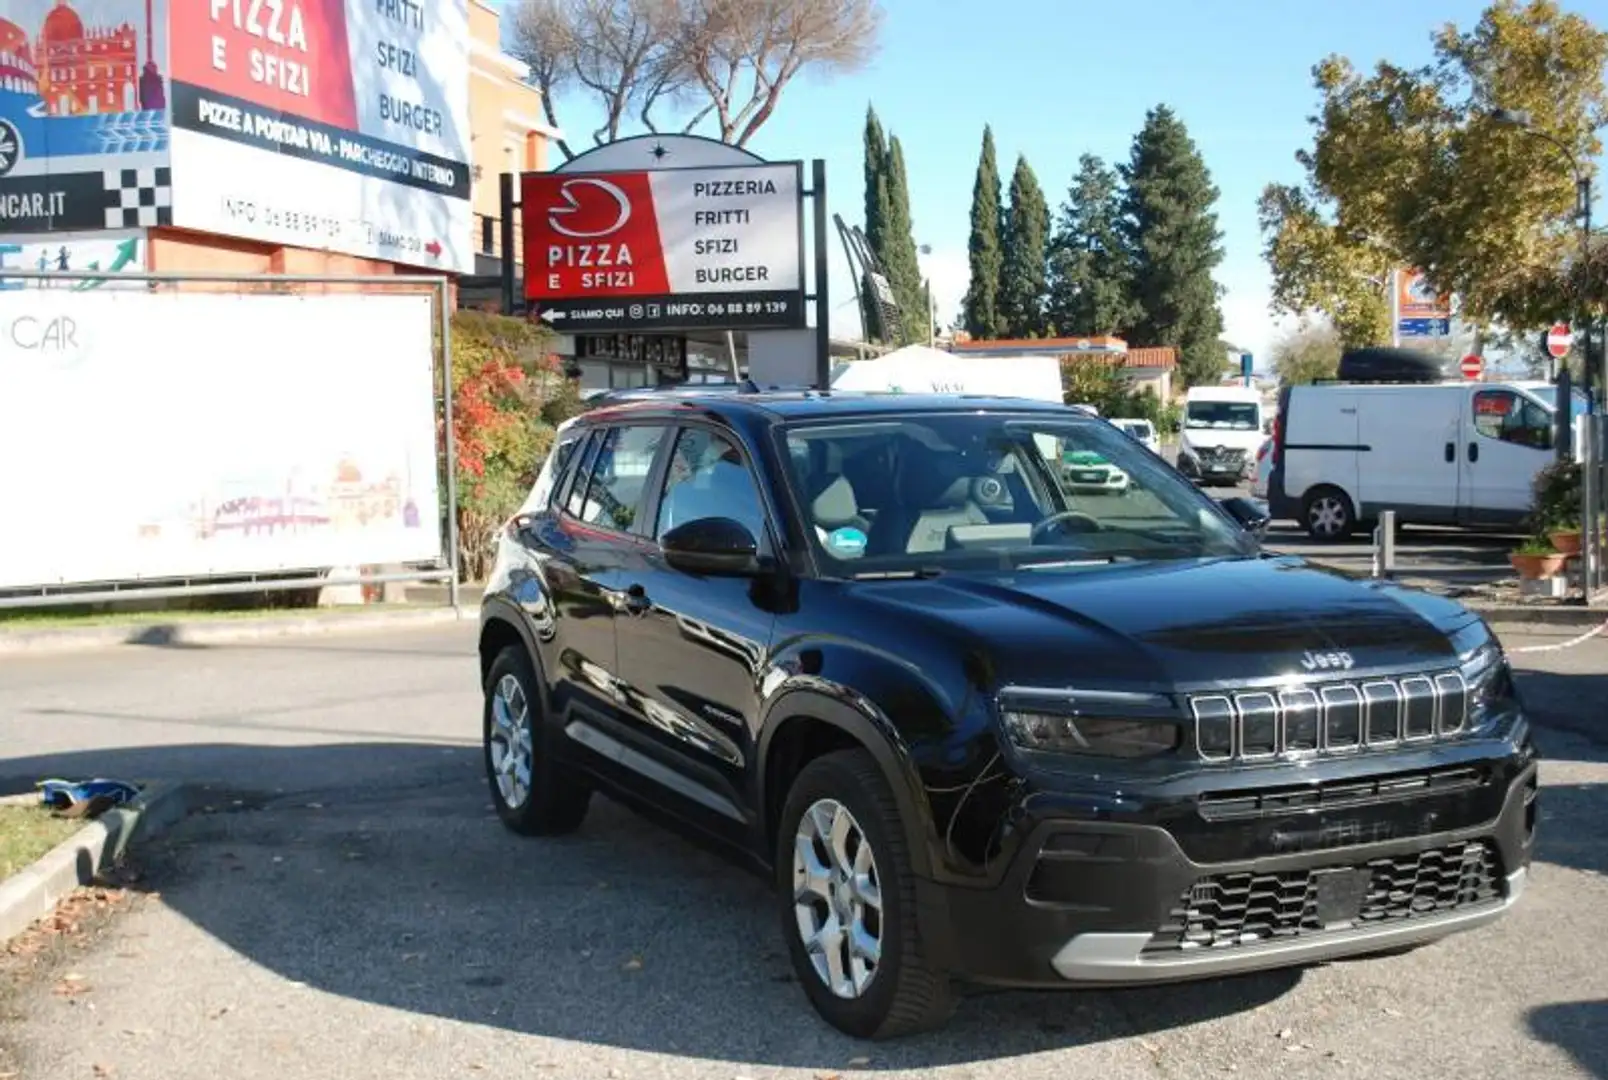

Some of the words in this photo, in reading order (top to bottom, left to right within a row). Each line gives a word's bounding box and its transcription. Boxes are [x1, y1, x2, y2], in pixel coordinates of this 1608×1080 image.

[212, 35, 227, 72] E
[249, 46, 309, 96] SFIZI
[377, 40, 417, 77] SFIZI
[379, 93, 442, 137] BURGER
[198, 97, 242, 131] PIZZE
[242, 111, 255, 135] A
[254, 114, 309, 149] PORTAR
[308, 129, 332, 155] VIA
[339, 138, 410, 175] PARCHEGGIO
[411, 160, 456, 187] INTERNO
[693, 180, 778, 197] PIZZERIA
[694, 209, 750, 226] FRITTI
[548, 244, 633, 268] PIZZA
[694, 239, 738, 255] SFIZI
[548, 272, 561, 289] E
[581, 270, 635, 289] SFIZI
[695, 266, 769, 283] BURGER
[570, 309, 604, 319] SIAMO
[605, 307, 624, 318] QUI
[666, 303, 705, 316] INFO:
[706, 303, 725, 315] 06
[727, 302, 744, 314] 88
[745, 301, 762, 313] 89
[764, 300, 788, 313] 139
[11, 315, 78, 351] CAR
[1300, 651, 1354, 670] Jeep
